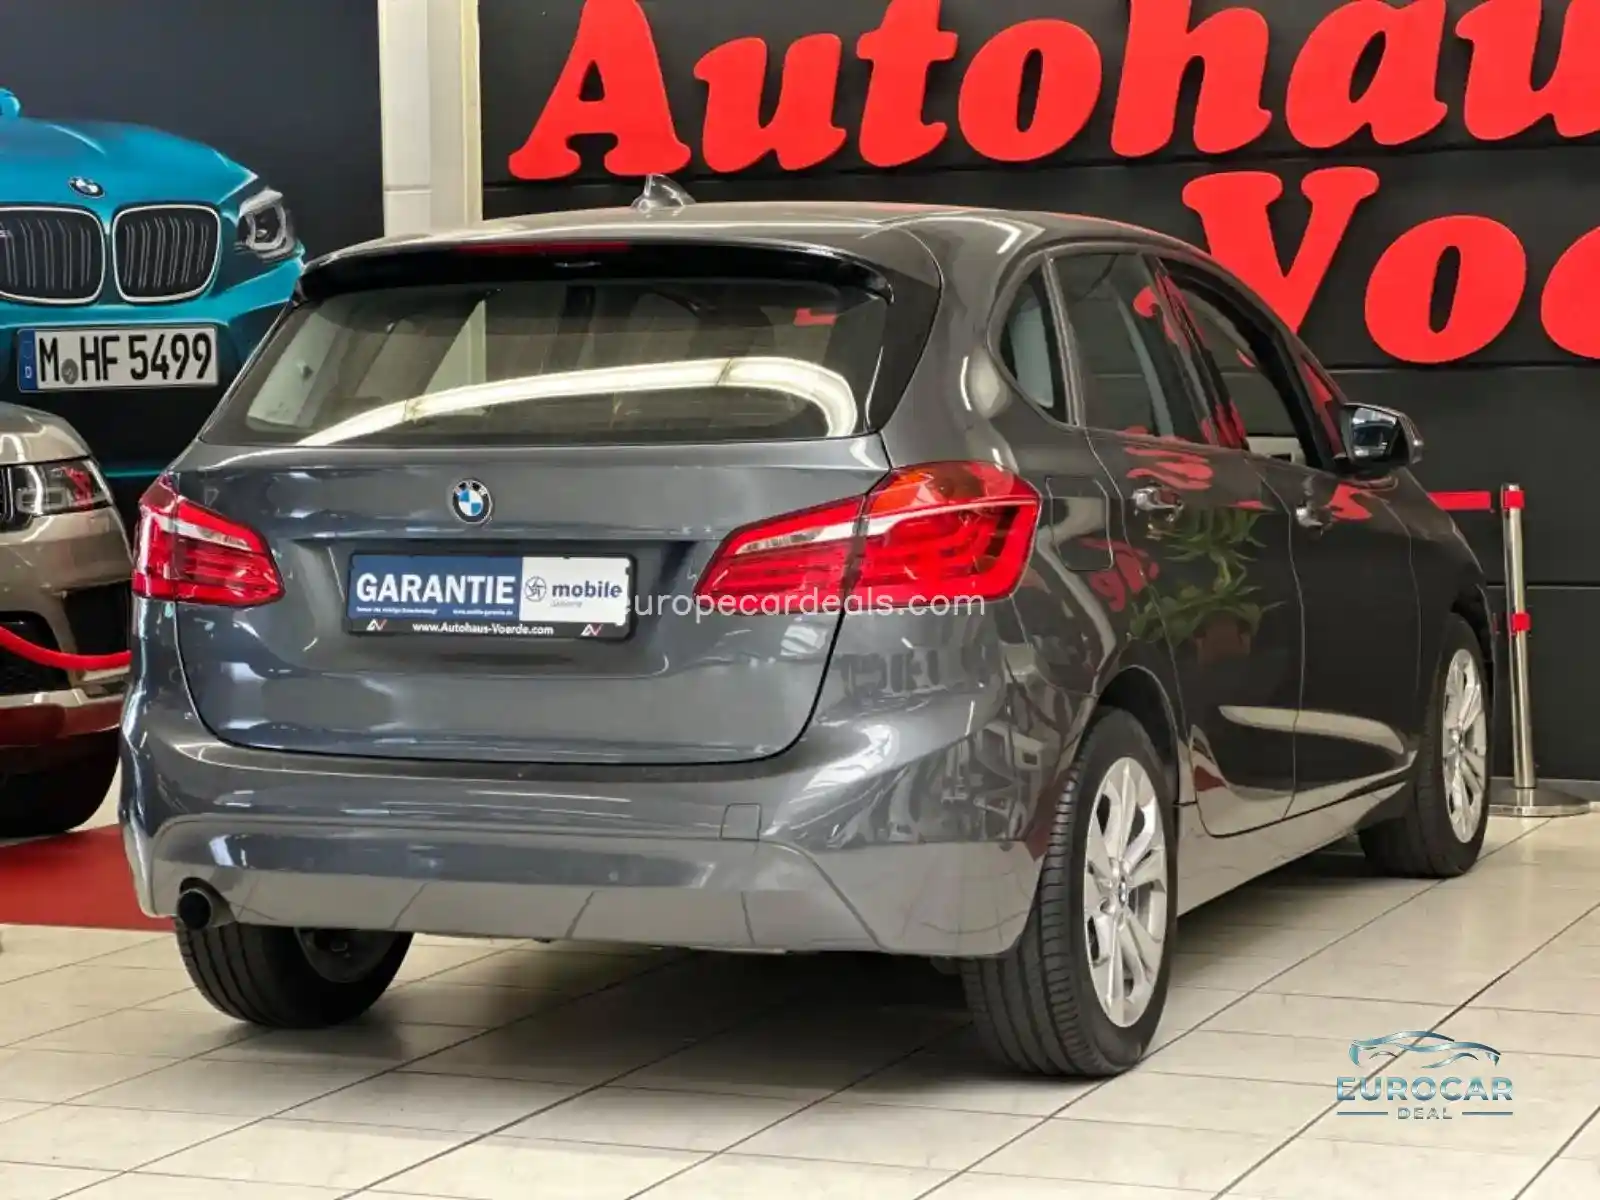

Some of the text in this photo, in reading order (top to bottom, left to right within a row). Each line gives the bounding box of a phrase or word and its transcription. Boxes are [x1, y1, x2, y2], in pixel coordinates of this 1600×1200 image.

[508, 0, 1600, 180] Autohau
[128, 332, 212, 381] 5499
[356, 572, 516, 605] GARANTIE
[552, 579, 623, 599] mobile
[412, 621, 554, 636] www.Autohaus-Voerde.com
